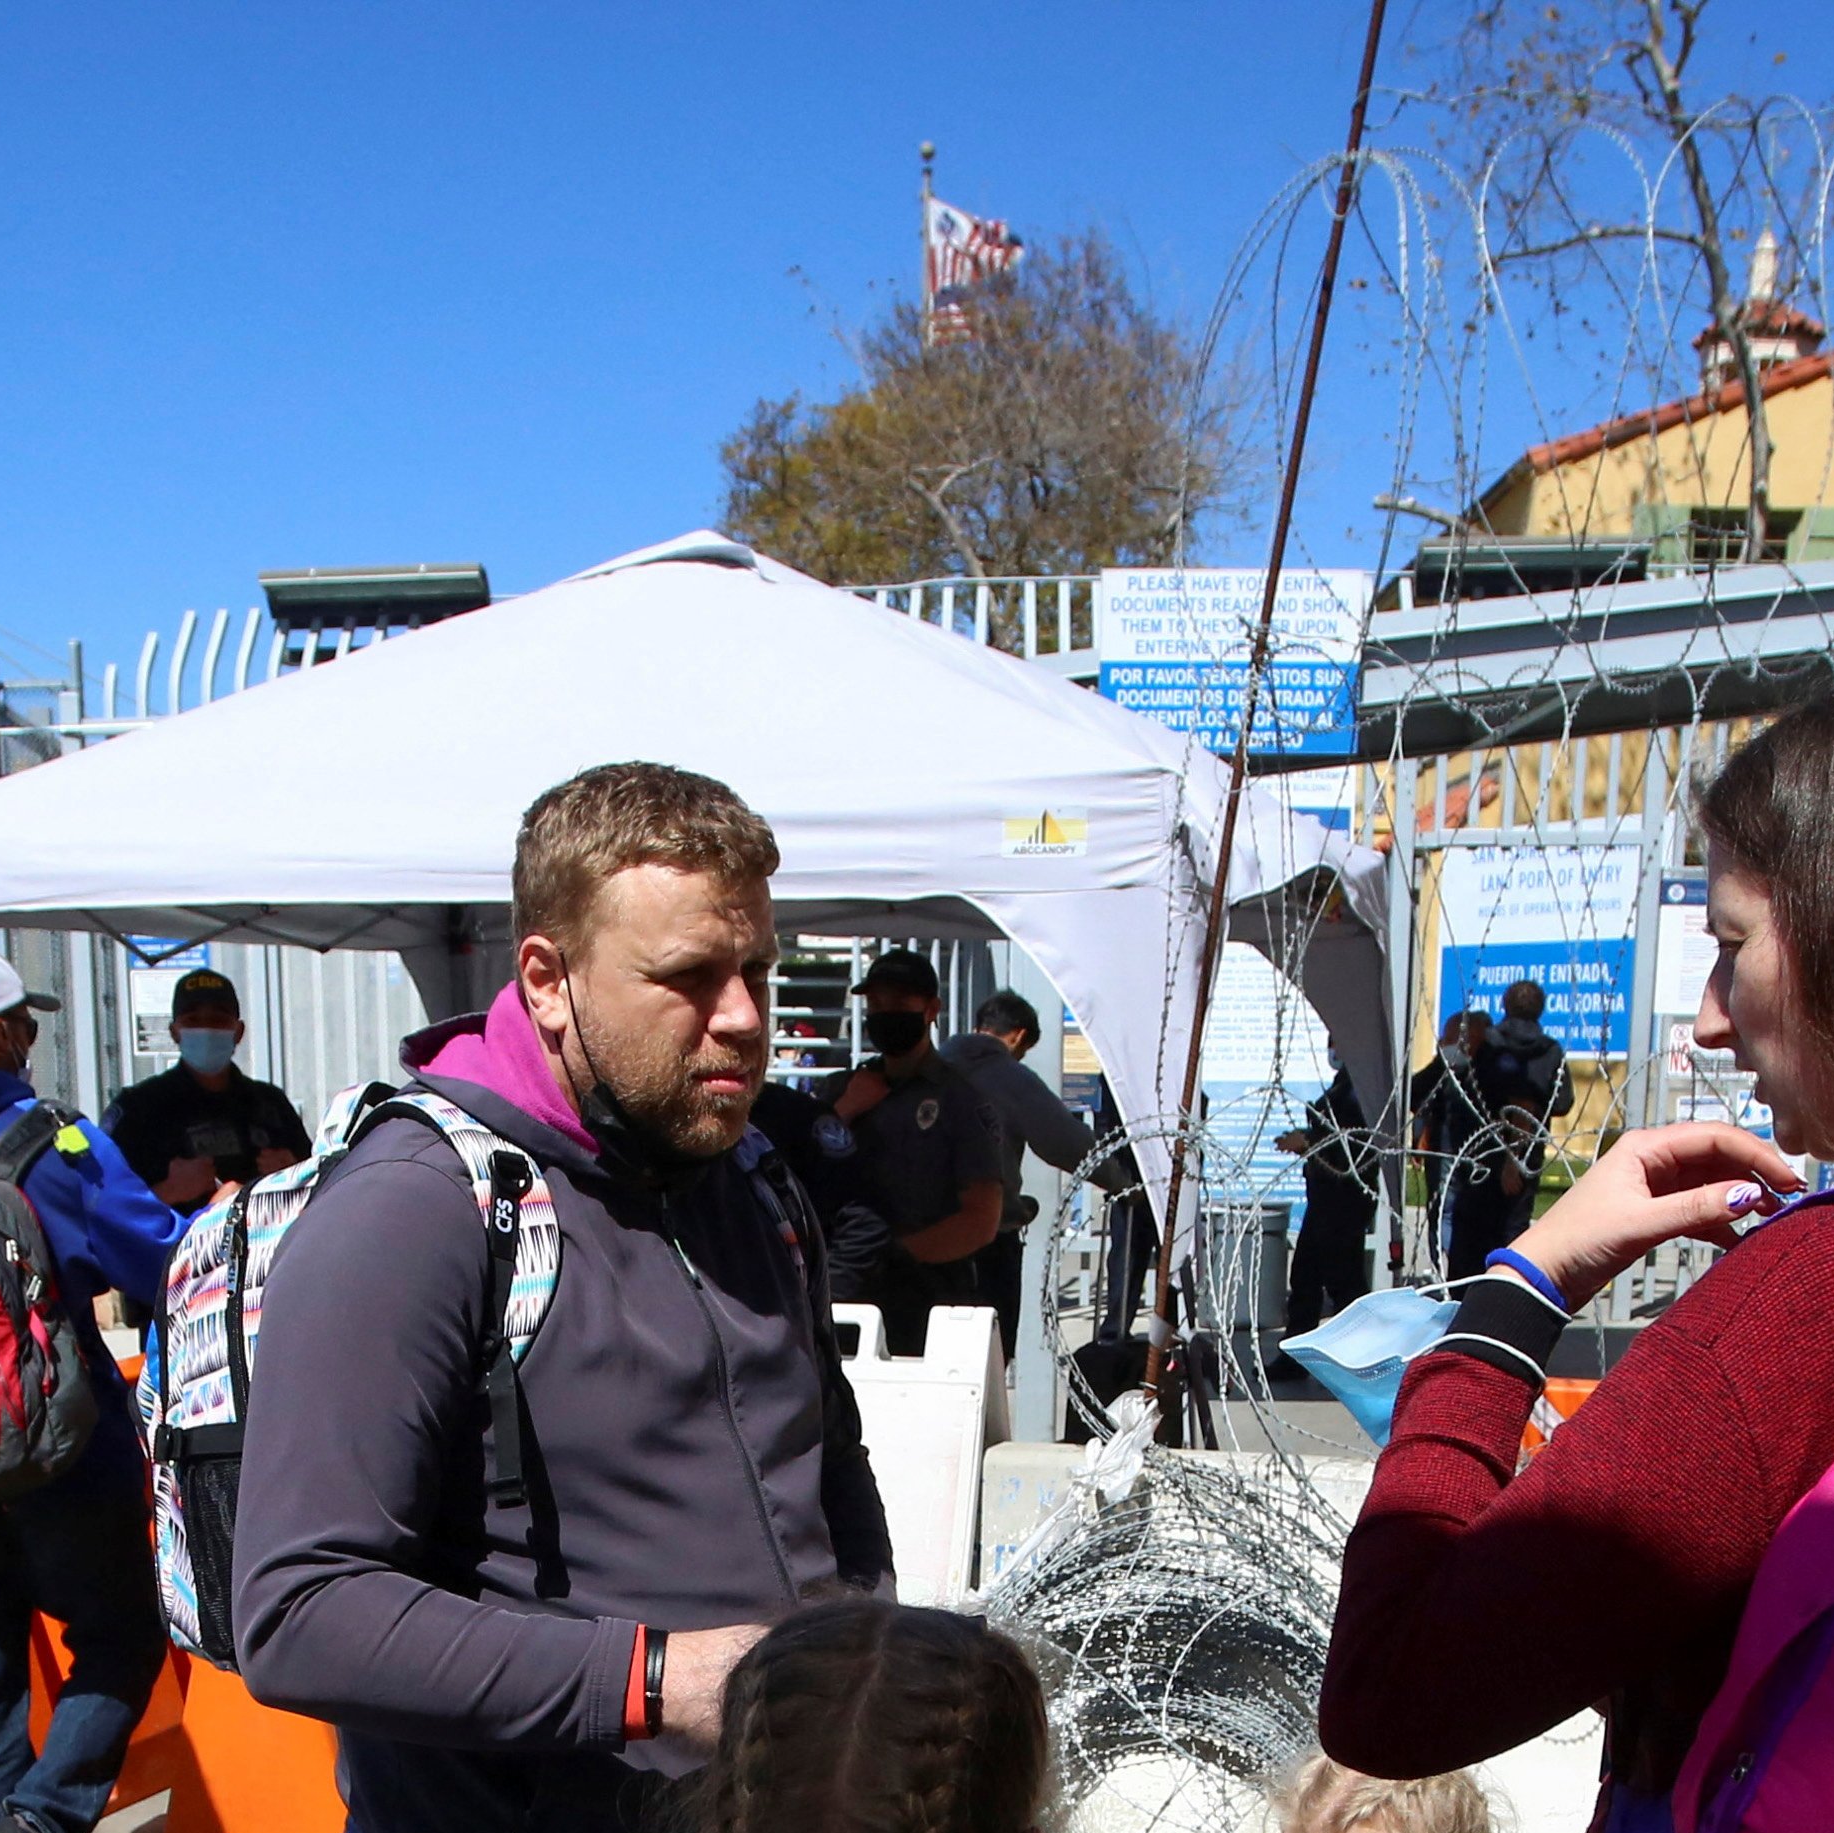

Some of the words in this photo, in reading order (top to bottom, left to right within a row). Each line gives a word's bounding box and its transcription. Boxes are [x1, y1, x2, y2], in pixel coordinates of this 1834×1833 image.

[1127, 576, 1184, 590] PLEASE
[1192, 576, 1230, 590] HAVE
[1284, 576, 1333, 591] ENTRY
[1111, 597, 1207, 612] DOCUMENTS
[1303, 597, 1349, 612] SHOW
[1121, 618, 1162, 632] THEM
[1168, 618, 1186, 632] TO
[1297, 618, 1337, 633] UPON
[1110, 668, 1143, 685] POR
[1147, 668, 1197, 685] FAVOR
[1314, 669, 1344, 686] SUS
[1012, 844, 1076, 855] ABCCANOPY
[1558, 868, 1574, 887] OF
[1479, 966, 1525, 985] PUERTO
[495, 1197, 514, 1233] CFS
